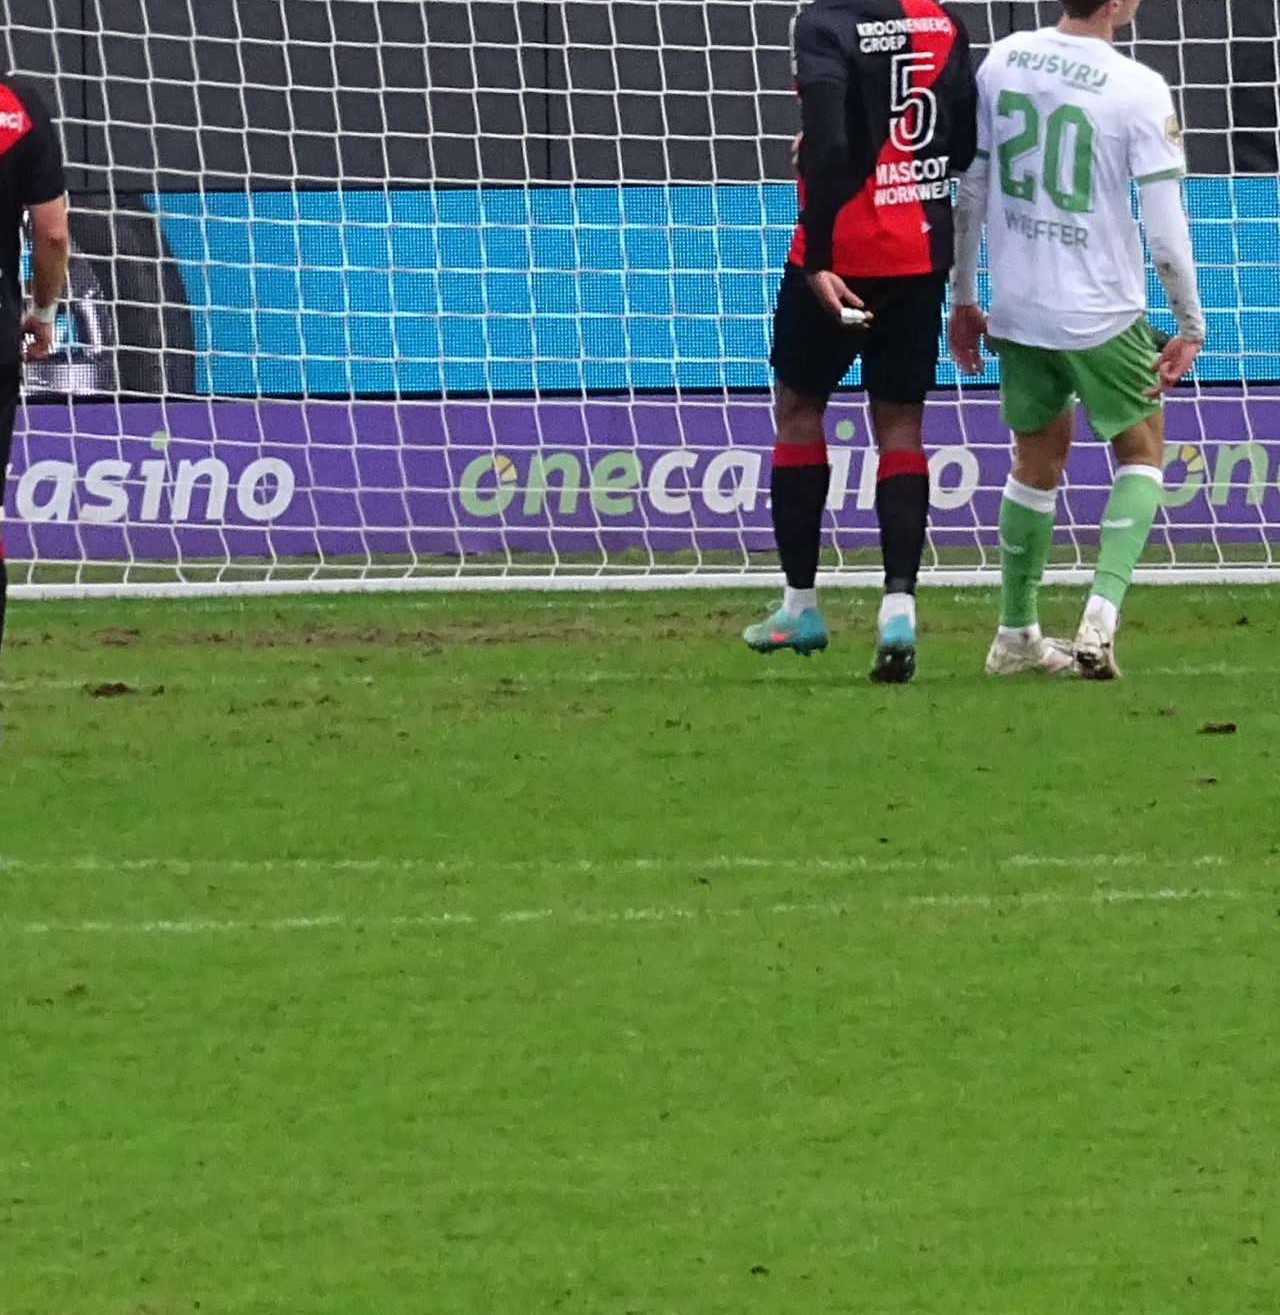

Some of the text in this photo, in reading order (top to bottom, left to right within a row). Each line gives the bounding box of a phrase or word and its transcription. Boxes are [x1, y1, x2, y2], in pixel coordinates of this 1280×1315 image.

[859, 34, 906, 54] GROEP
[889, 51, 937, 152] 5
[997, 89, 1094, 213] 20
